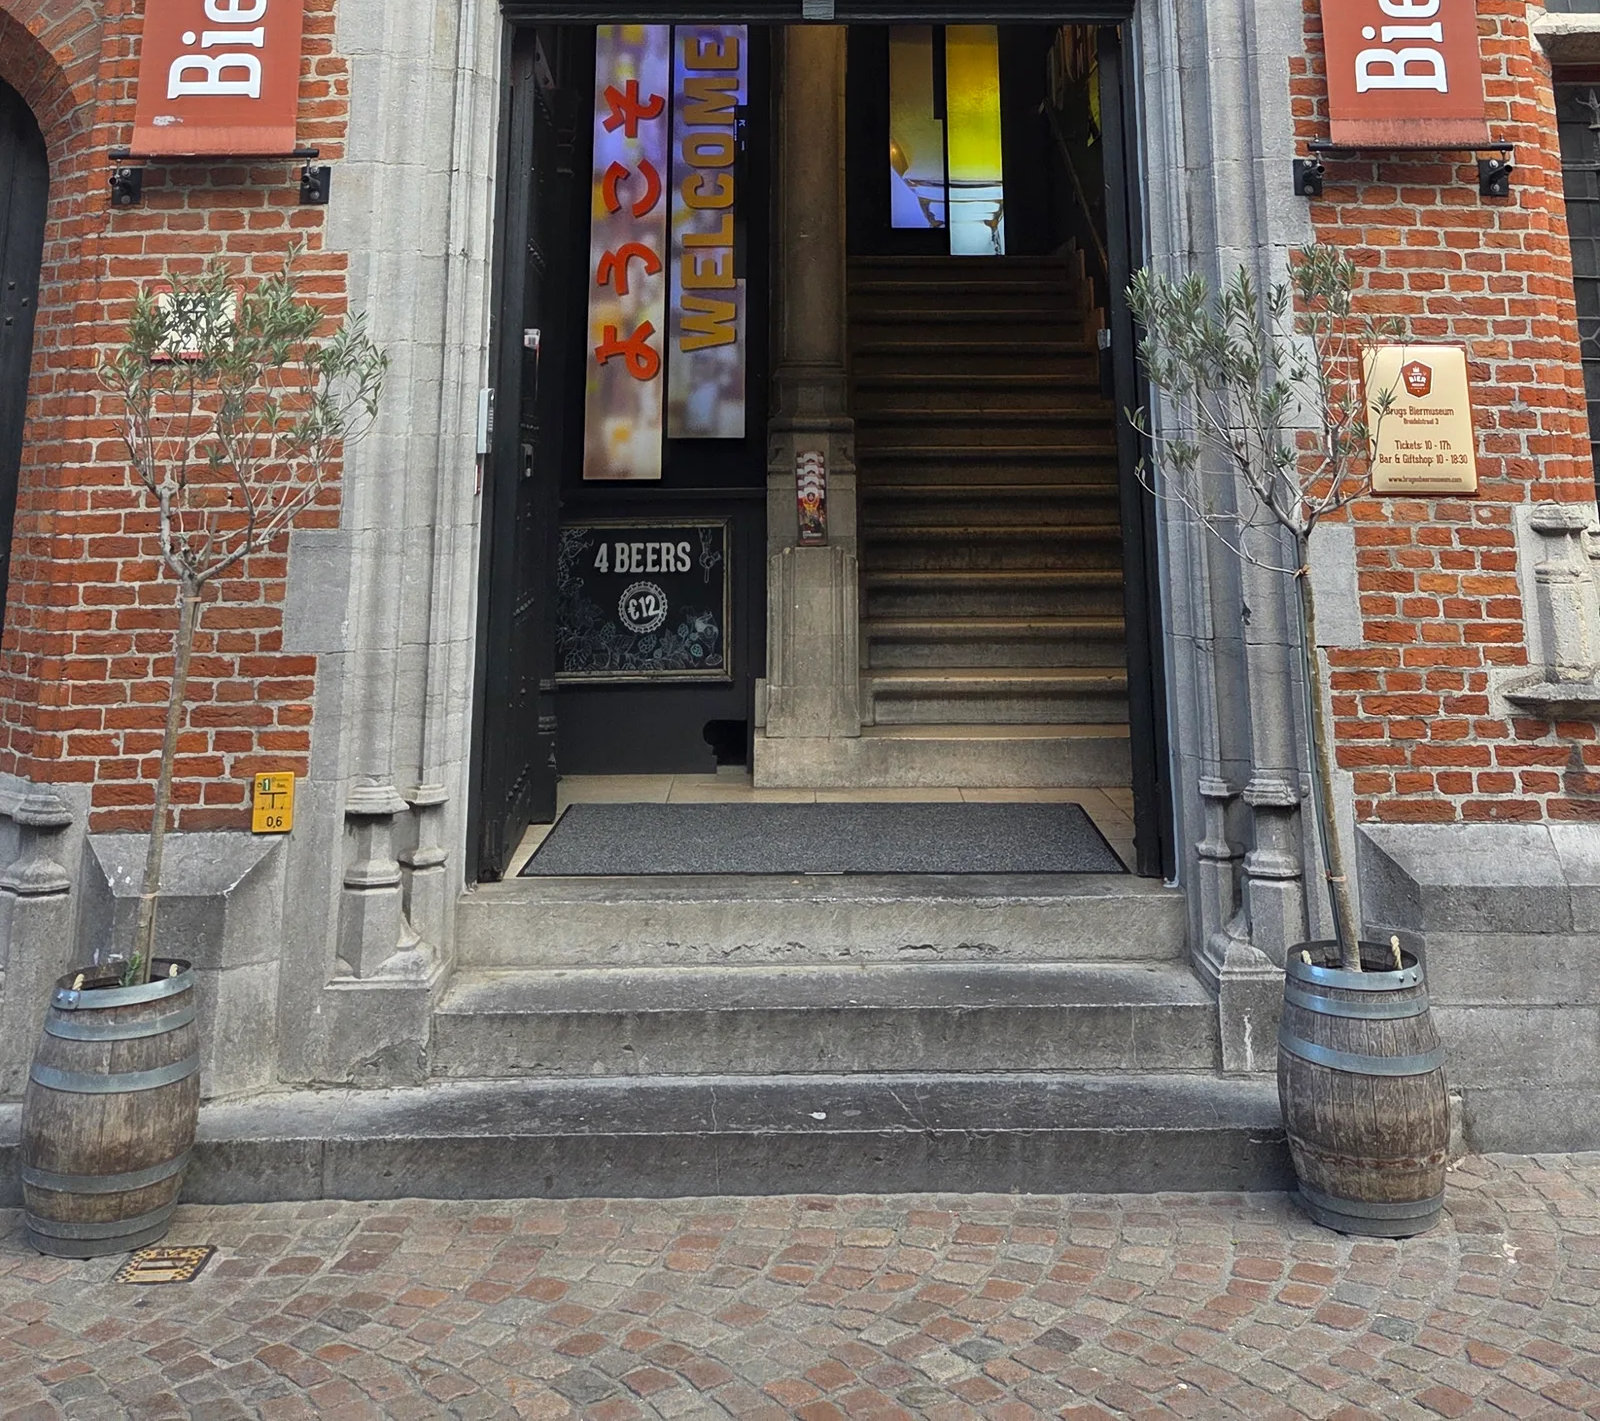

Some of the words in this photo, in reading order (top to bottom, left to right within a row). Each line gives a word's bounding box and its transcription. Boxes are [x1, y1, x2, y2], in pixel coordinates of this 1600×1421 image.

[680, 36, 740, 353] WELCOME
[595, 79, 665, 381] ようこそ
[1386, 405, 1407, 418] Brugs
[1409, 406, 1454, 416] Biermuseum
[1395, 440, 1422, 450] Tickets:
[1425, 440, 1432, 450] 10
[1439, 440, 1451, 450] 17h
[1379, 454, 1392, 464] Bar
[1395, 454, 1400, 464] &
[1403, 454, 1433, 467] Giftshop:
[1436, 454, 1443, 464] 10
[594, 543, 609, 573] 4
[614, 542, 691, 573] BEERS
[627, 595, 661, 621] €12
